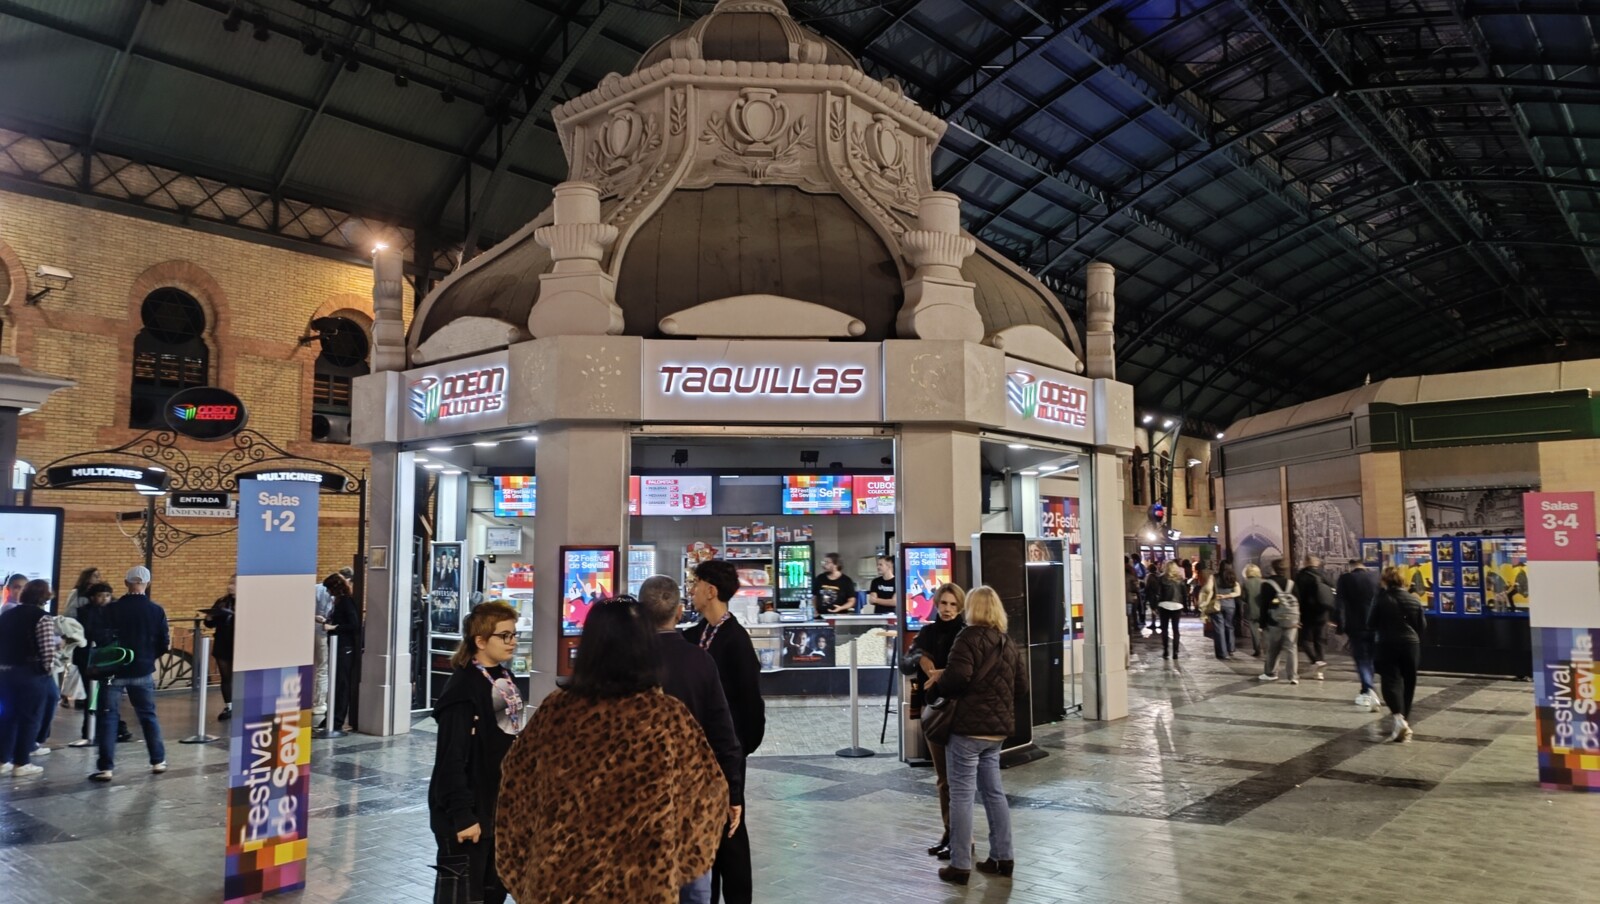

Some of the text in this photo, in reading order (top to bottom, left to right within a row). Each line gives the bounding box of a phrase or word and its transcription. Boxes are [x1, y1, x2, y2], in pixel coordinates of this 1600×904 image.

[71, 467, 143, 480] MULTICINES
[256, 472, 323, 483] MULTICINES
[819, 487, 846, 498] SeFF
[179, 496, 220, 504] ENTRADA
[258, 491, 300, 507] Salas
[1541, 500, 1579, 511] Salas
[1042, 511, 1055, 528] 22
[1554, 530, 1569, 547] 5
[568, 554, 610, 562] 22 Festival
[908, 551, 948, 559] 22 Festival
[569, 561, 609, 569] de Sevilla
[909, 558, 948, 566] de Sevilla
[1570, 633, 1600, 752] de Sevilla
[1546, 664, 1574, 749] Festival
[271, 673, 302, 839] de Sevilla
[240, 721, 273, 843] Festival
